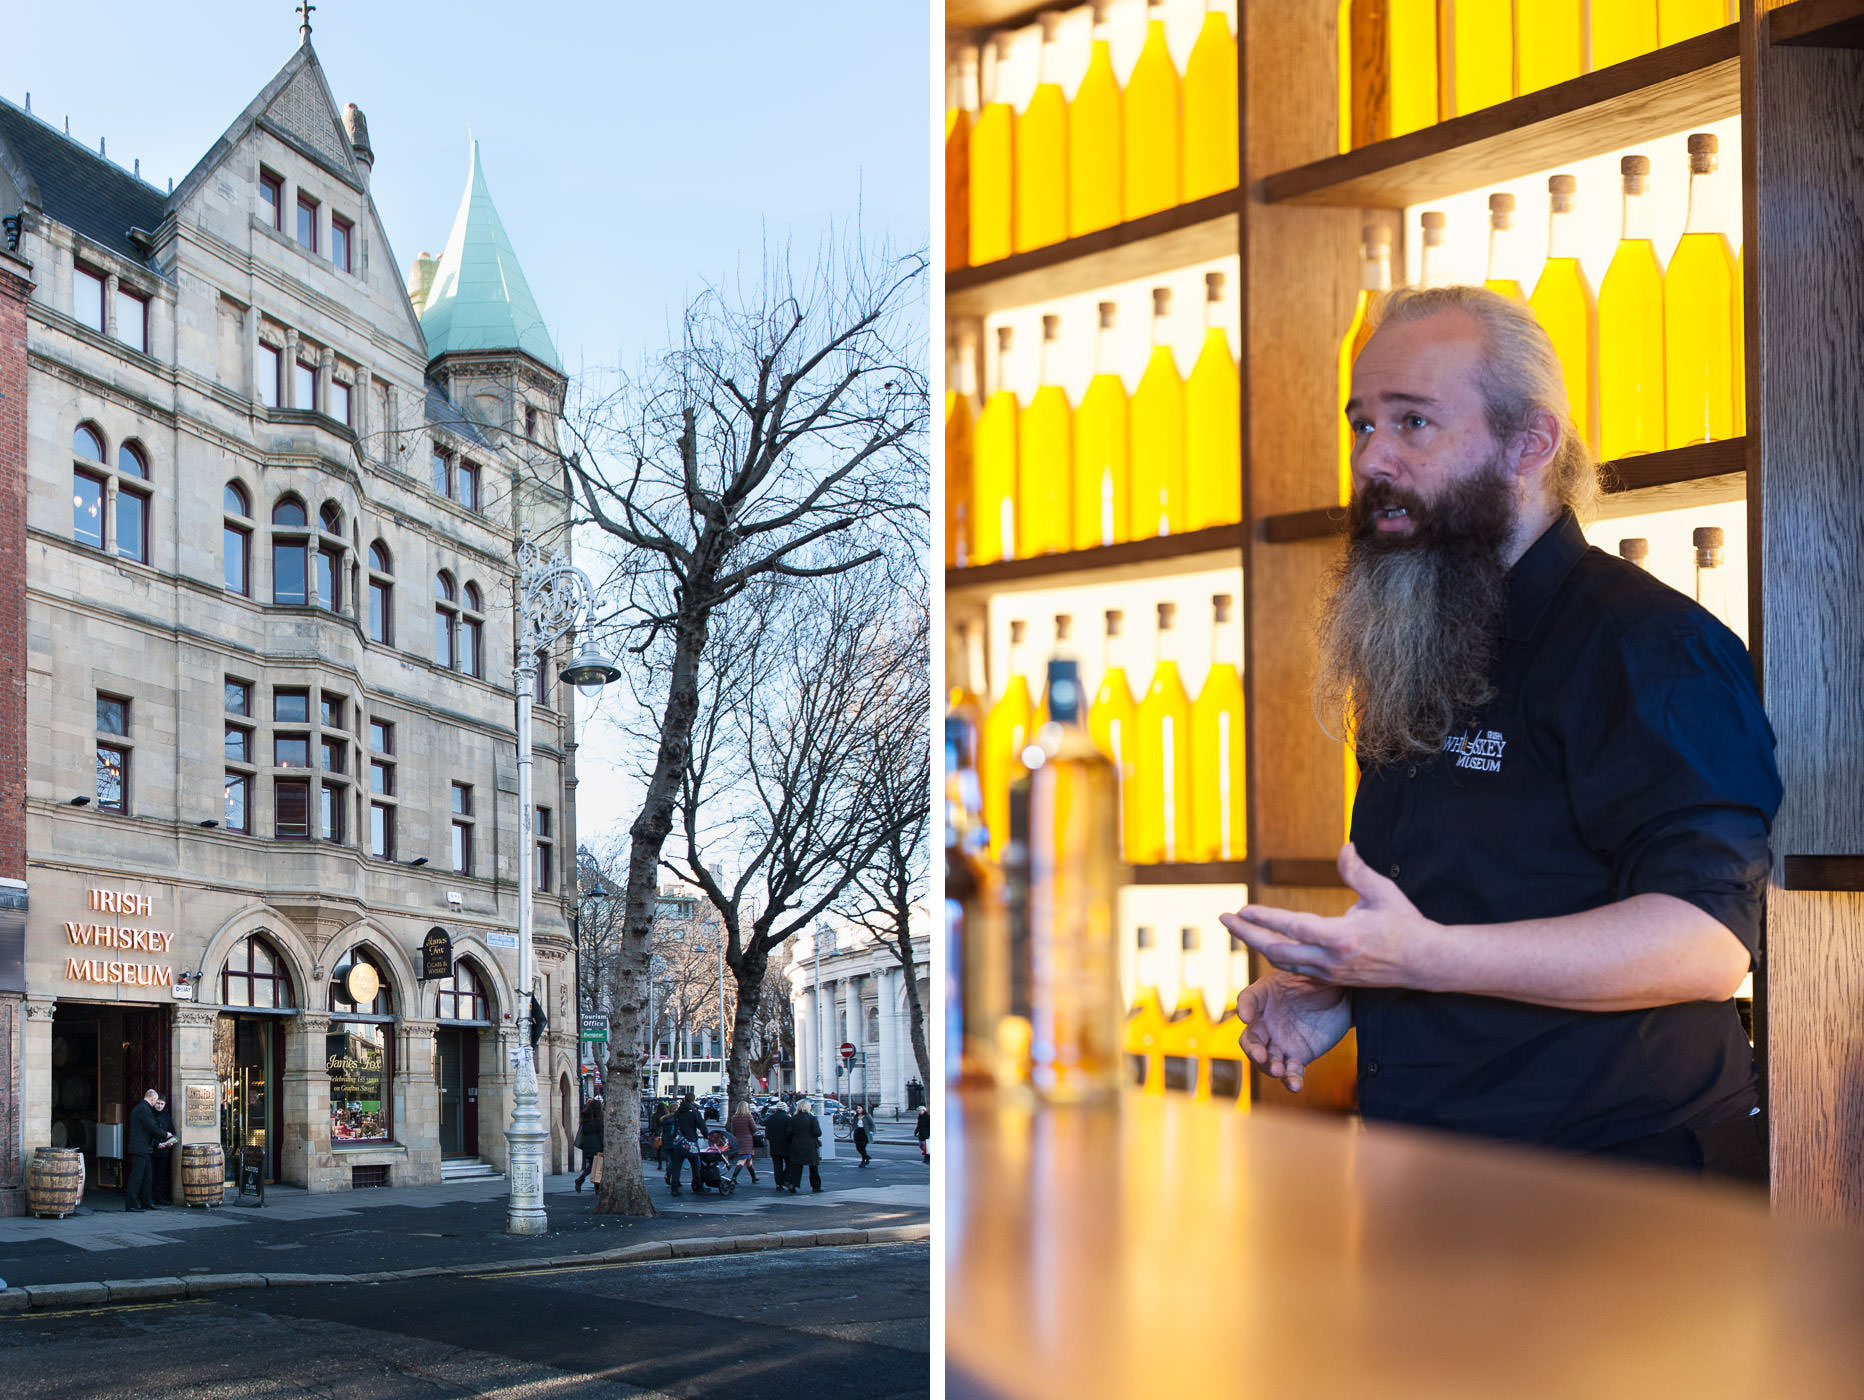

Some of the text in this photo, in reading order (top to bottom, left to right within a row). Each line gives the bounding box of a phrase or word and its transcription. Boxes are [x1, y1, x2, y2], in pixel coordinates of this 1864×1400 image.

[1456, 755, 1501, 773] MUSEUM
[88, 888, 152, 917] IRISH
[65, 921, 175, 953] WHISKEY
[66, 957, 173, 986] MUSEUM
[326, 1054, 382, 1071] James Fox
